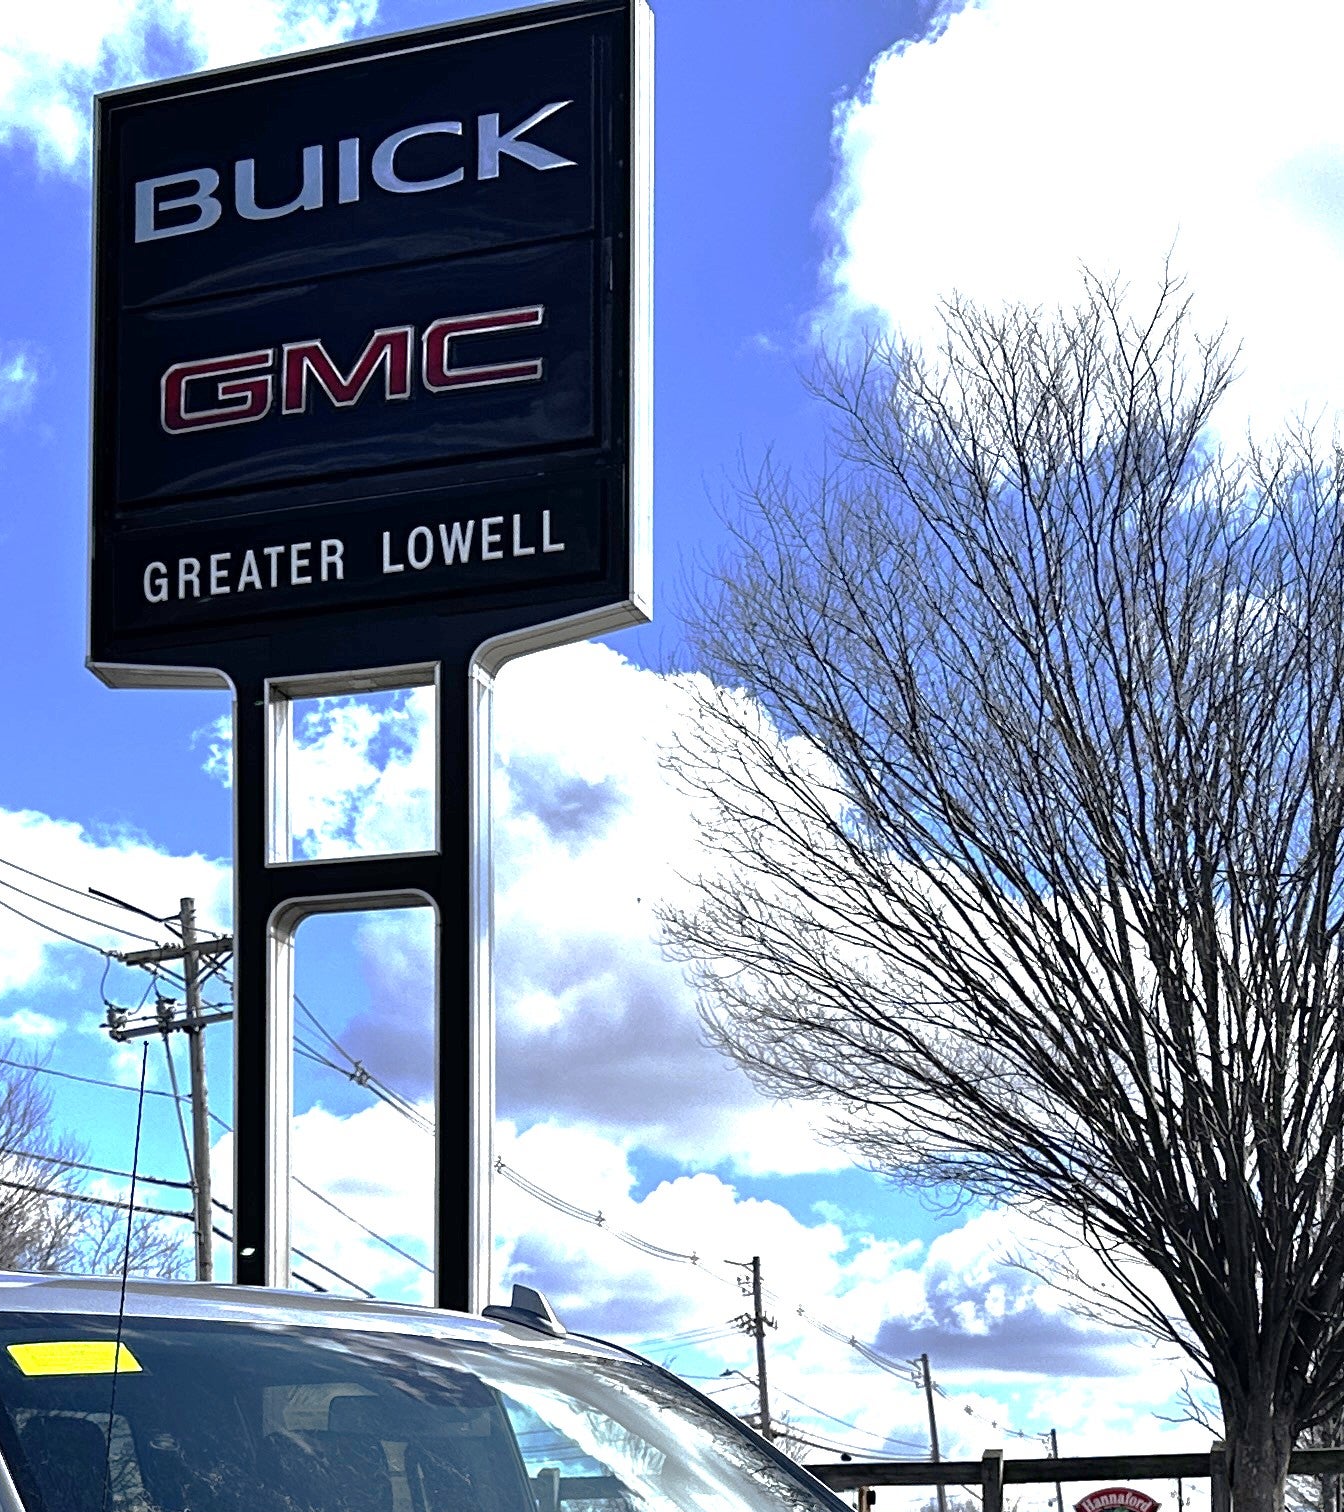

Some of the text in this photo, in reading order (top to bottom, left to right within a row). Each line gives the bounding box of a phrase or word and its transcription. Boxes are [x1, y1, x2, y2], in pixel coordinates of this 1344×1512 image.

[134, 99, 579, 243] BUICK
[160, 304, 544, 435] GMC
[142, 509, 566, 604] GREATER LOWELL
[1081, 1491, 1153, 1512] Hannaford
